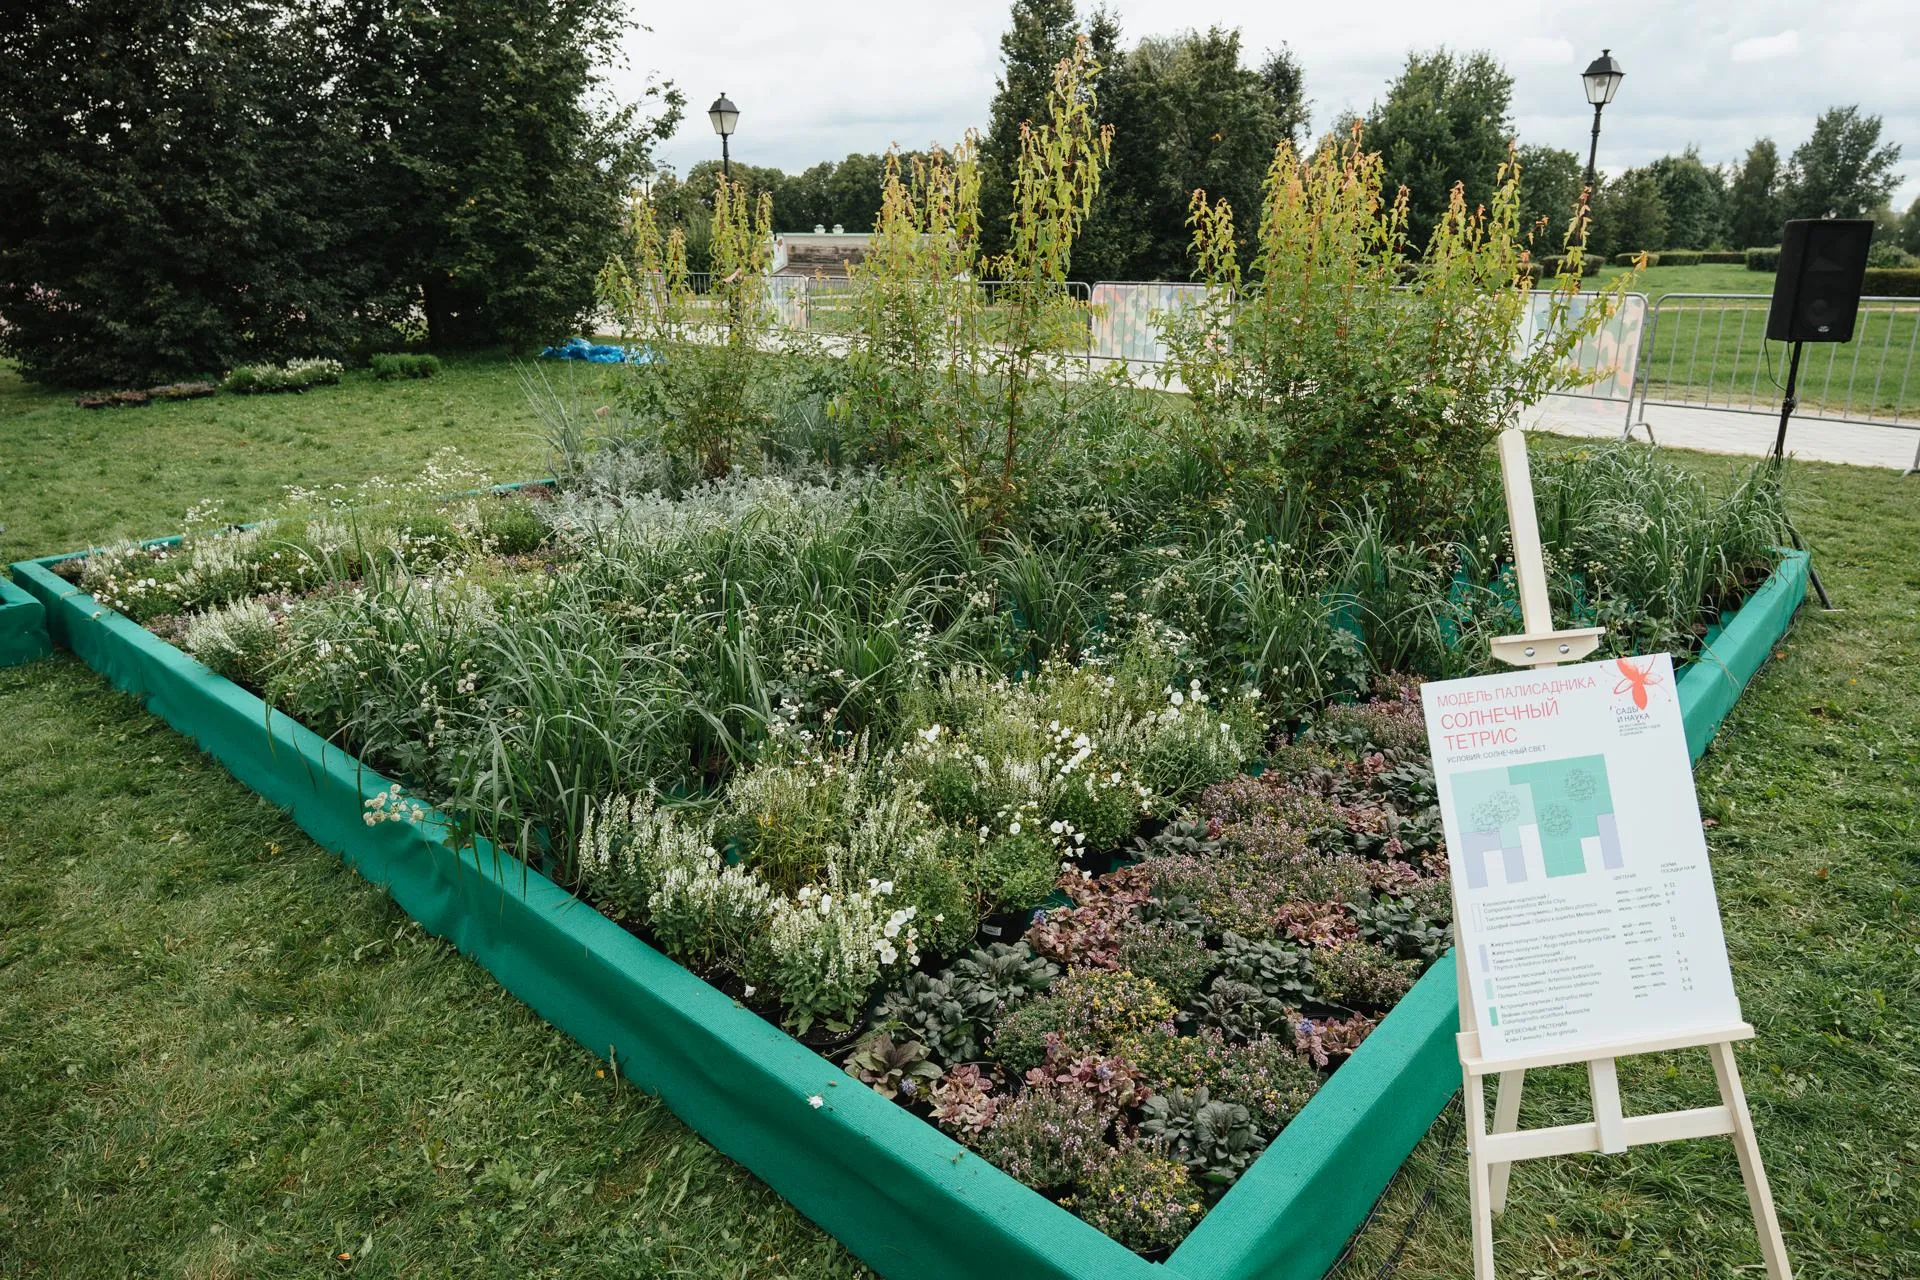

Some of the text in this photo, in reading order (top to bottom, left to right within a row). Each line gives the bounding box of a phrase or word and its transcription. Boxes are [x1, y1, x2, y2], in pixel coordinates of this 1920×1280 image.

[1437, 676, 1596, 707] МОДЕЛЬ ПАЛИСАДНИКА
[1441, 697, 1559, 729] СОЛНЕЧНЫЙ
[1444, 727, 1518, 751] ТЕТРИС
